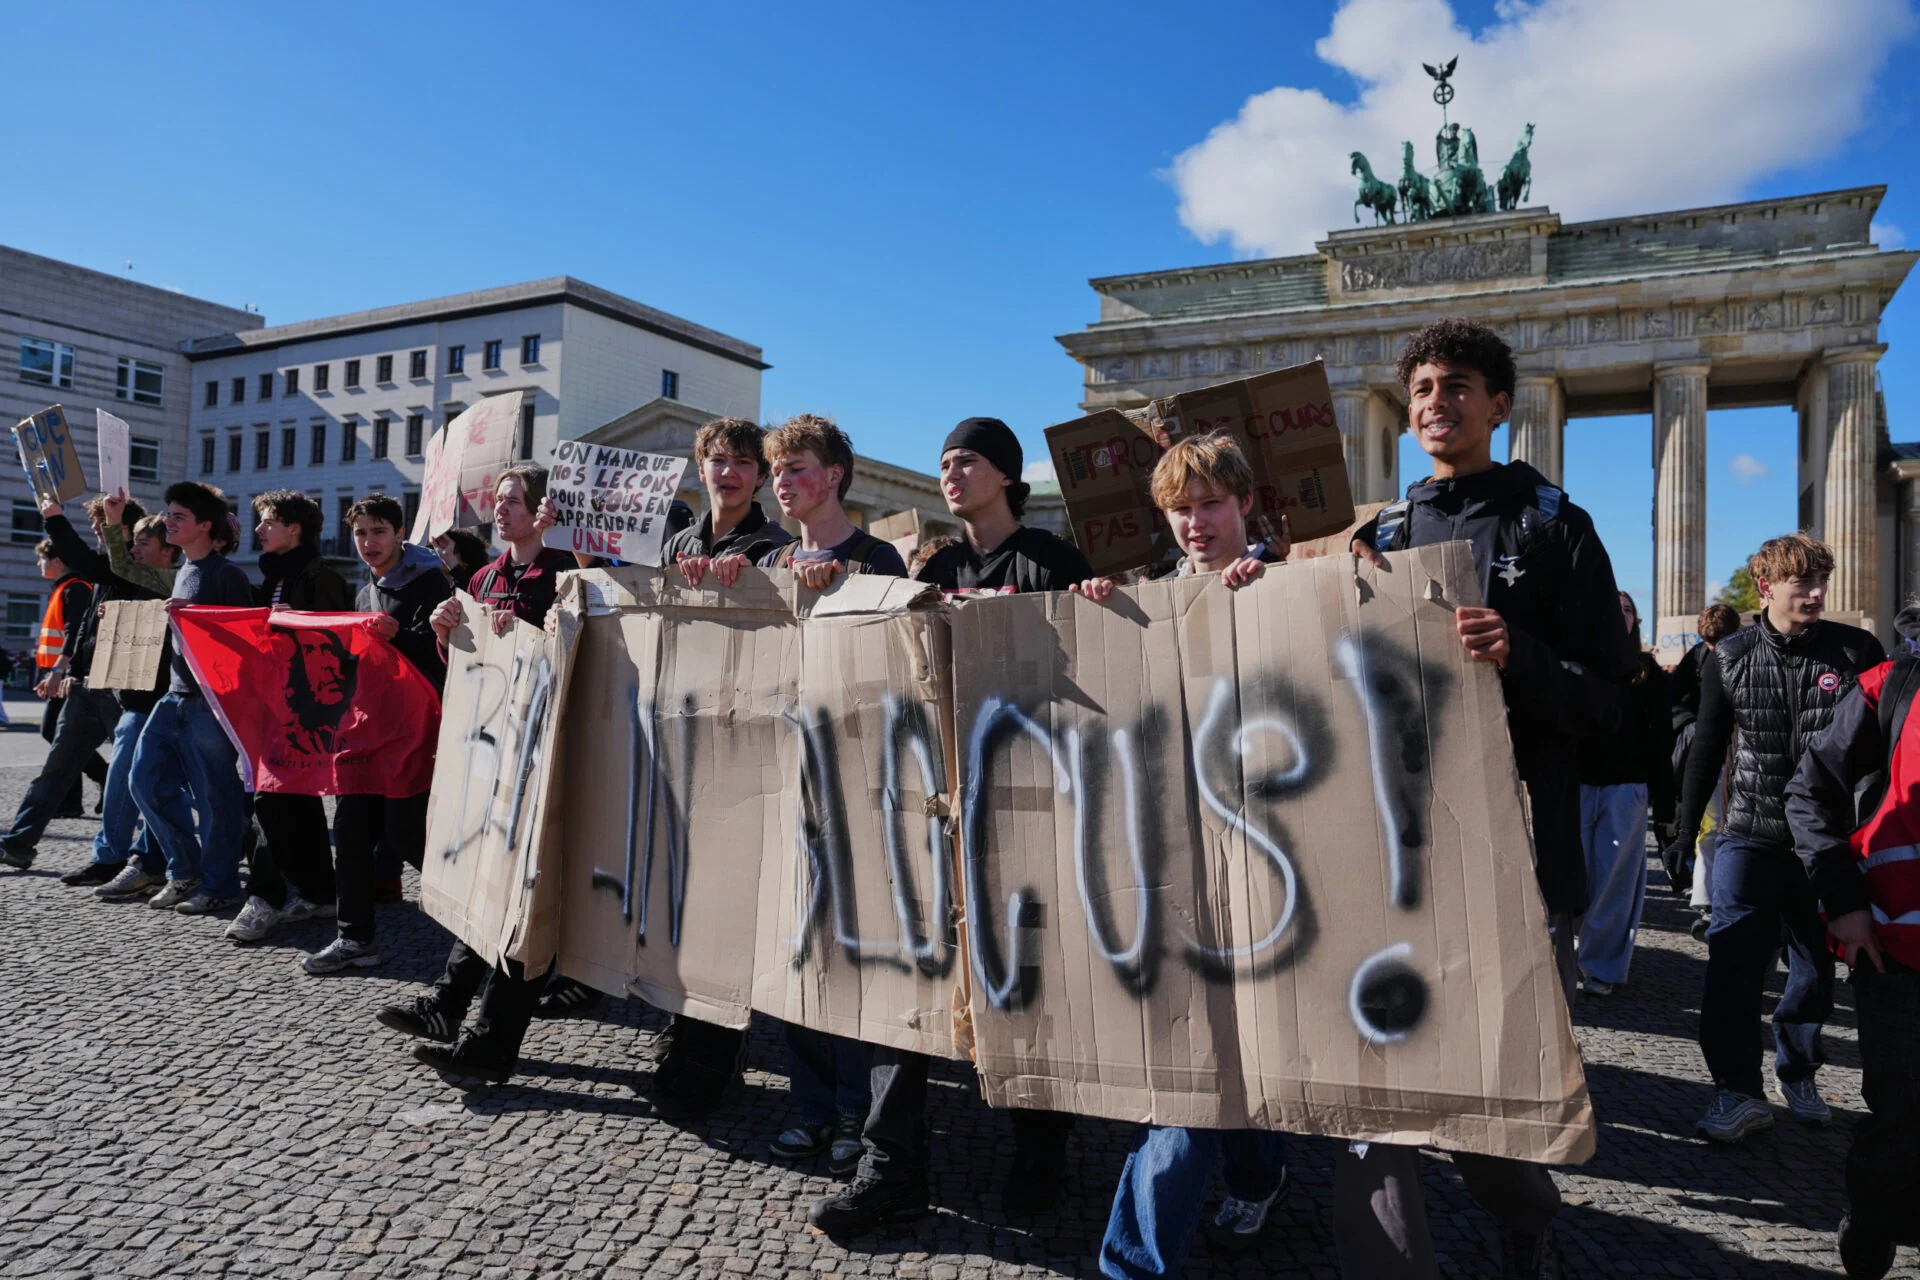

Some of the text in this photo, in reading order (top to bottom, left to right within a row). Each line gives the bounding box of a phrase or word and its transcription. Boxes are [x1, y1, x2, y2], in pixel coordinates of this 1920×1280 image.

[1244, 402, 1335, 439] COURS
[558, 441, 676, 472] ON MANQUE
[550, 464, 679, 497] NOS LEÇONS
[549, 487, 586, 509] POUR
[645, 496, 672, 516] EN
[555, 509, 653, 534] APPRENDRE
[1084, 512, 1140, 554] PAS
[572, 528, 623, 555] UNE
